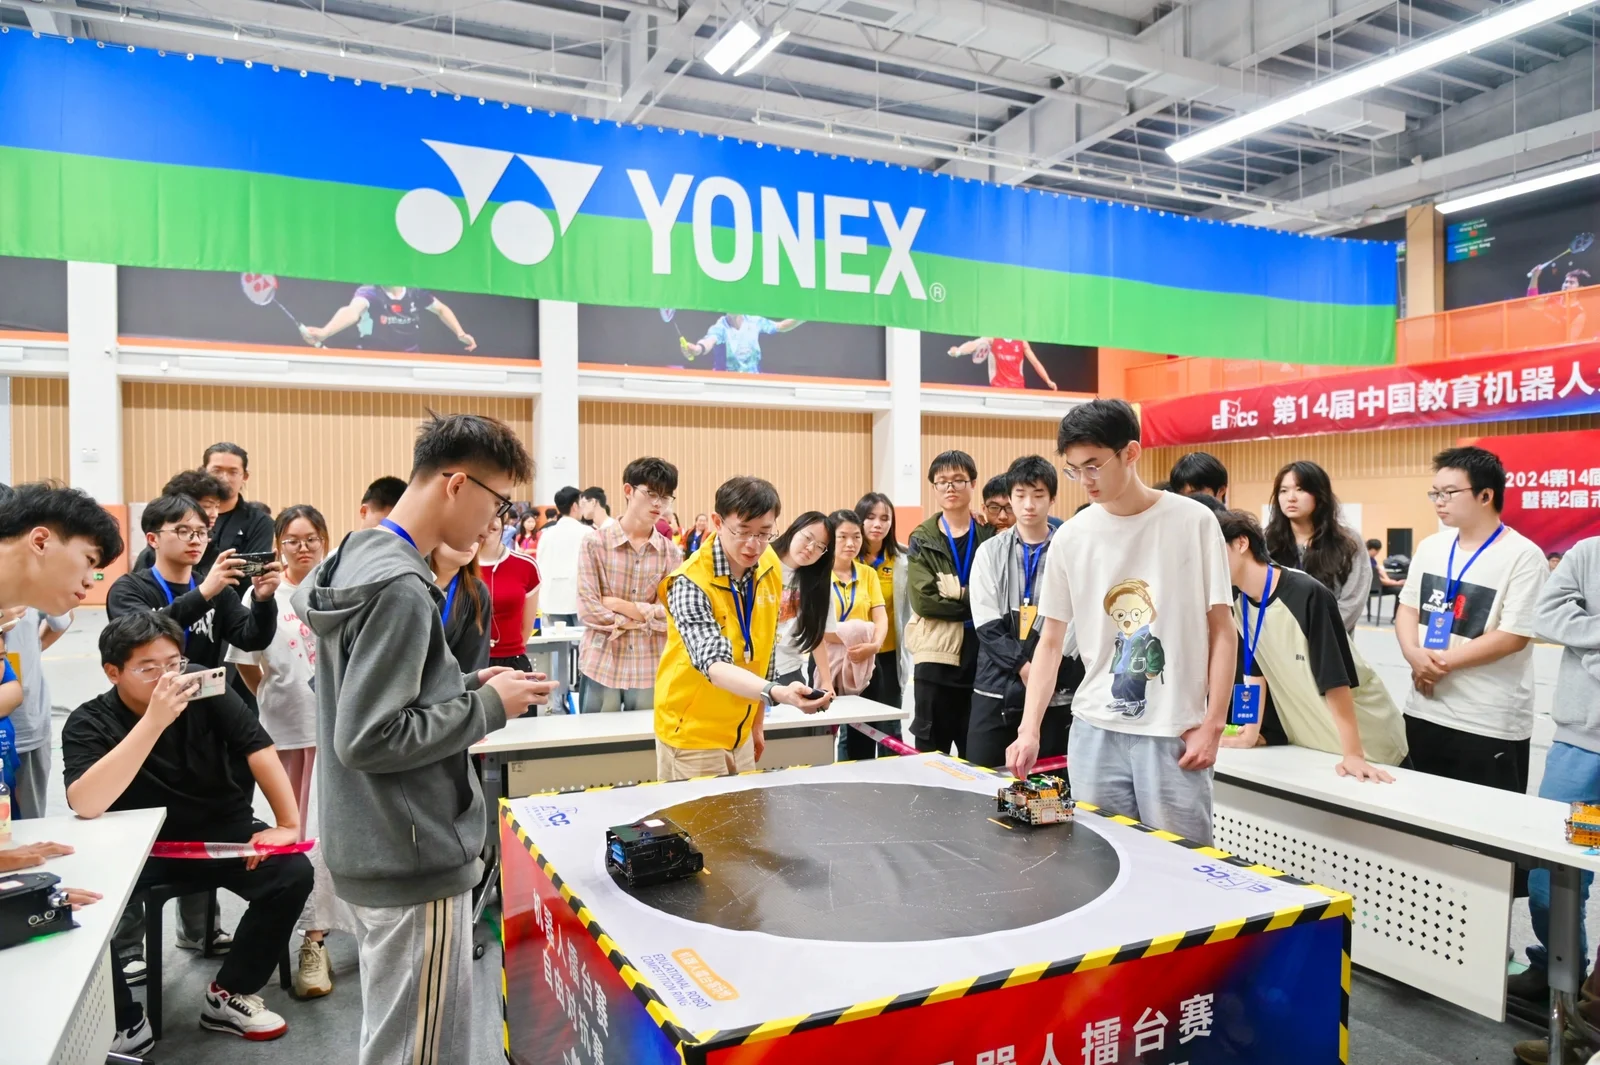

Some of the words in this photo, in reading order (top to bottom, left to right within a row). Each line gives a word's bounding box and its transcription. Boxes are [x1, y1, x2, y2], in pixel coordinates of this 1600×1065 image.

[626, 168, 927, 300] YONEX
[1272, 361, 1600, 425] 第14届中国教育机器人
[653, 953, 690, 990] EDUCATIONAL
[686, 990, 712, 1010] ROBOT
[938, 993, 1214, 1065] 人擂台赛
